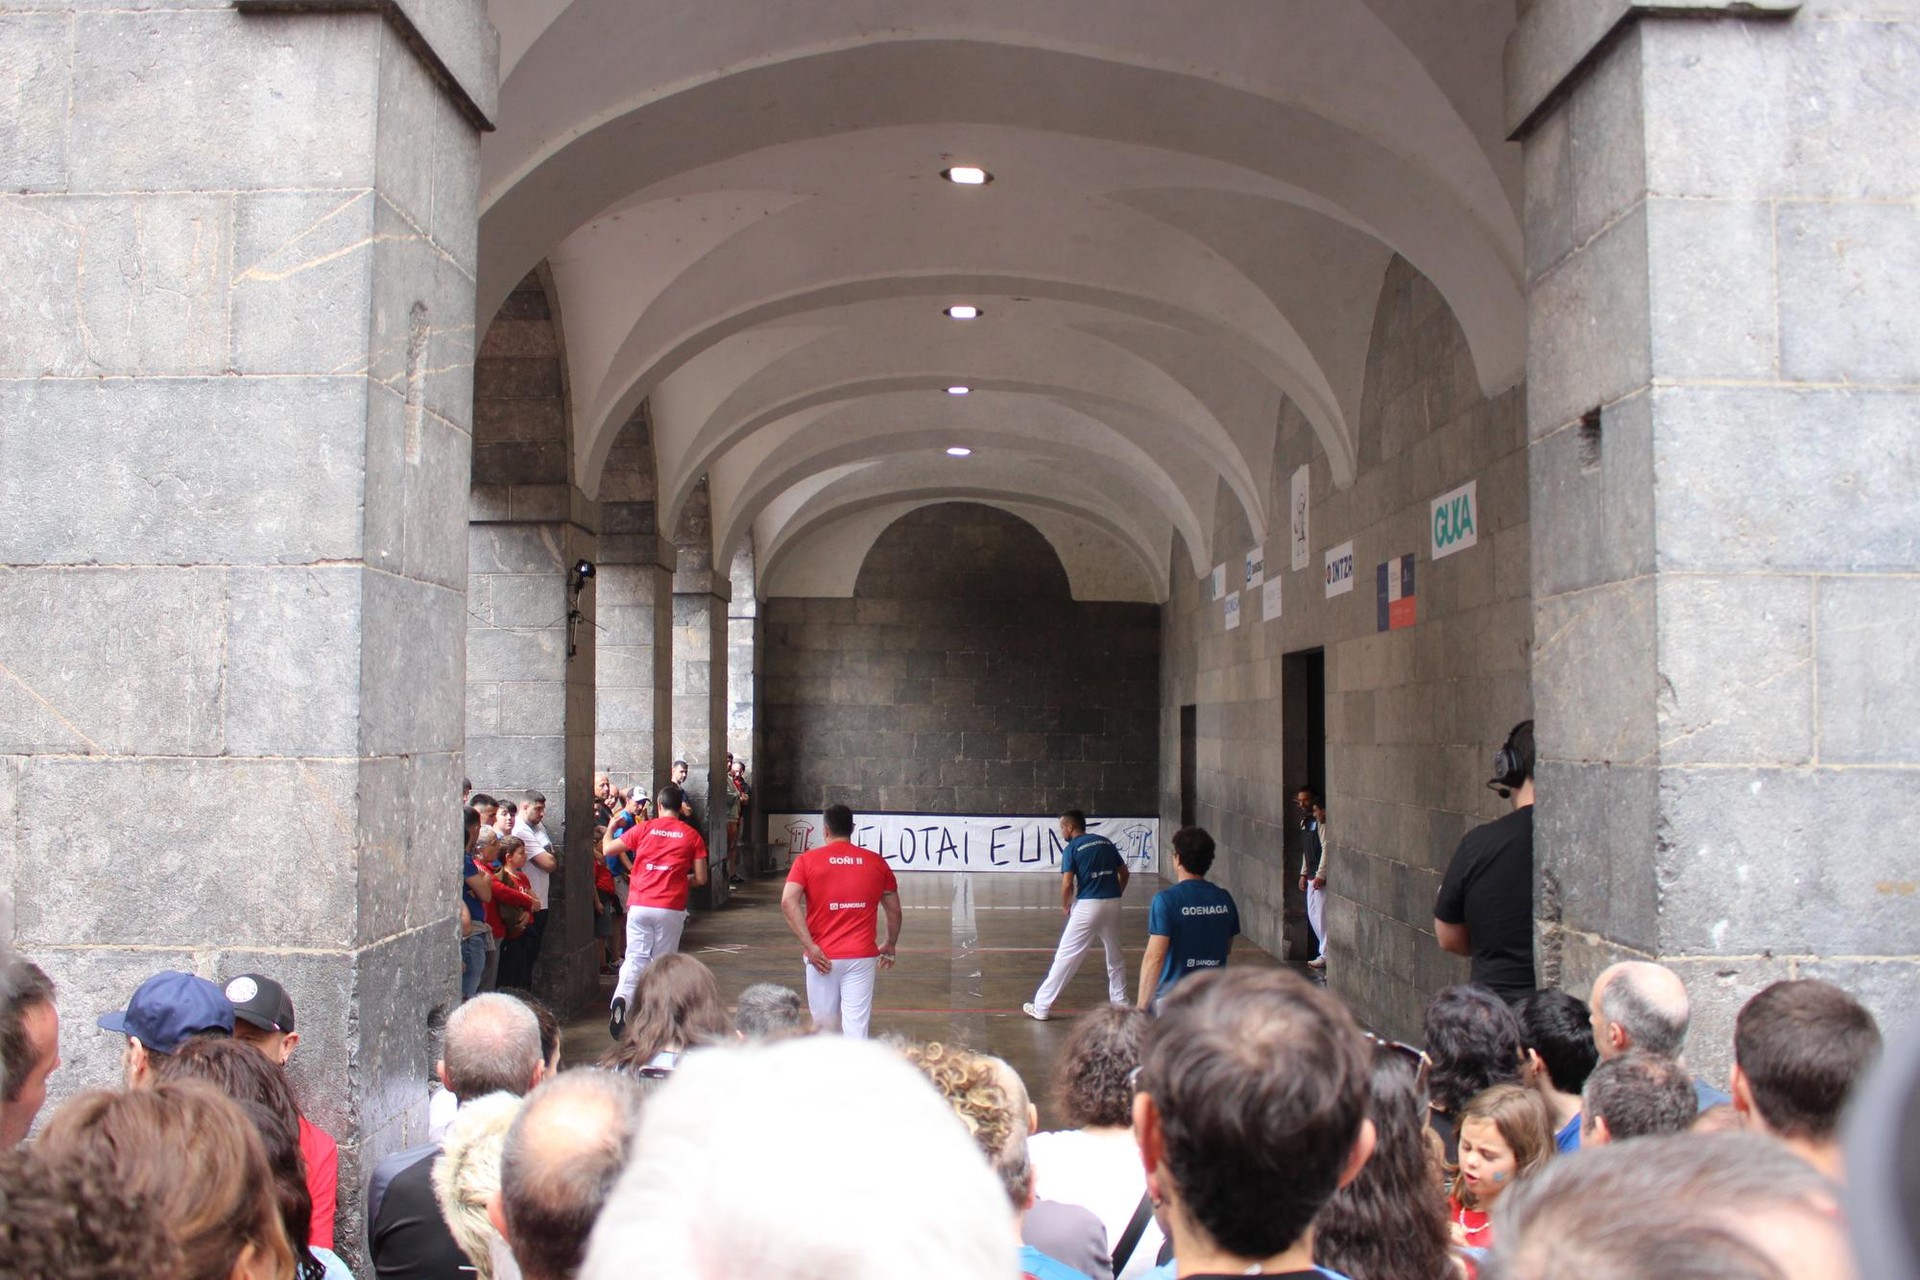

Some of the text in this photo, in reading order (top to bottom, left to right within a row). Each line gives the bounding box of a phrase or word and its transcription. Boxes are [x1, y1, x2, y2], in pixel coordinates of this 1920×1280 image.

[650, 829, 684, 838] ANDREU
[829, 856, 854, 865] GOÑI
[1181, 905, 1229, 916] GOENAGA
